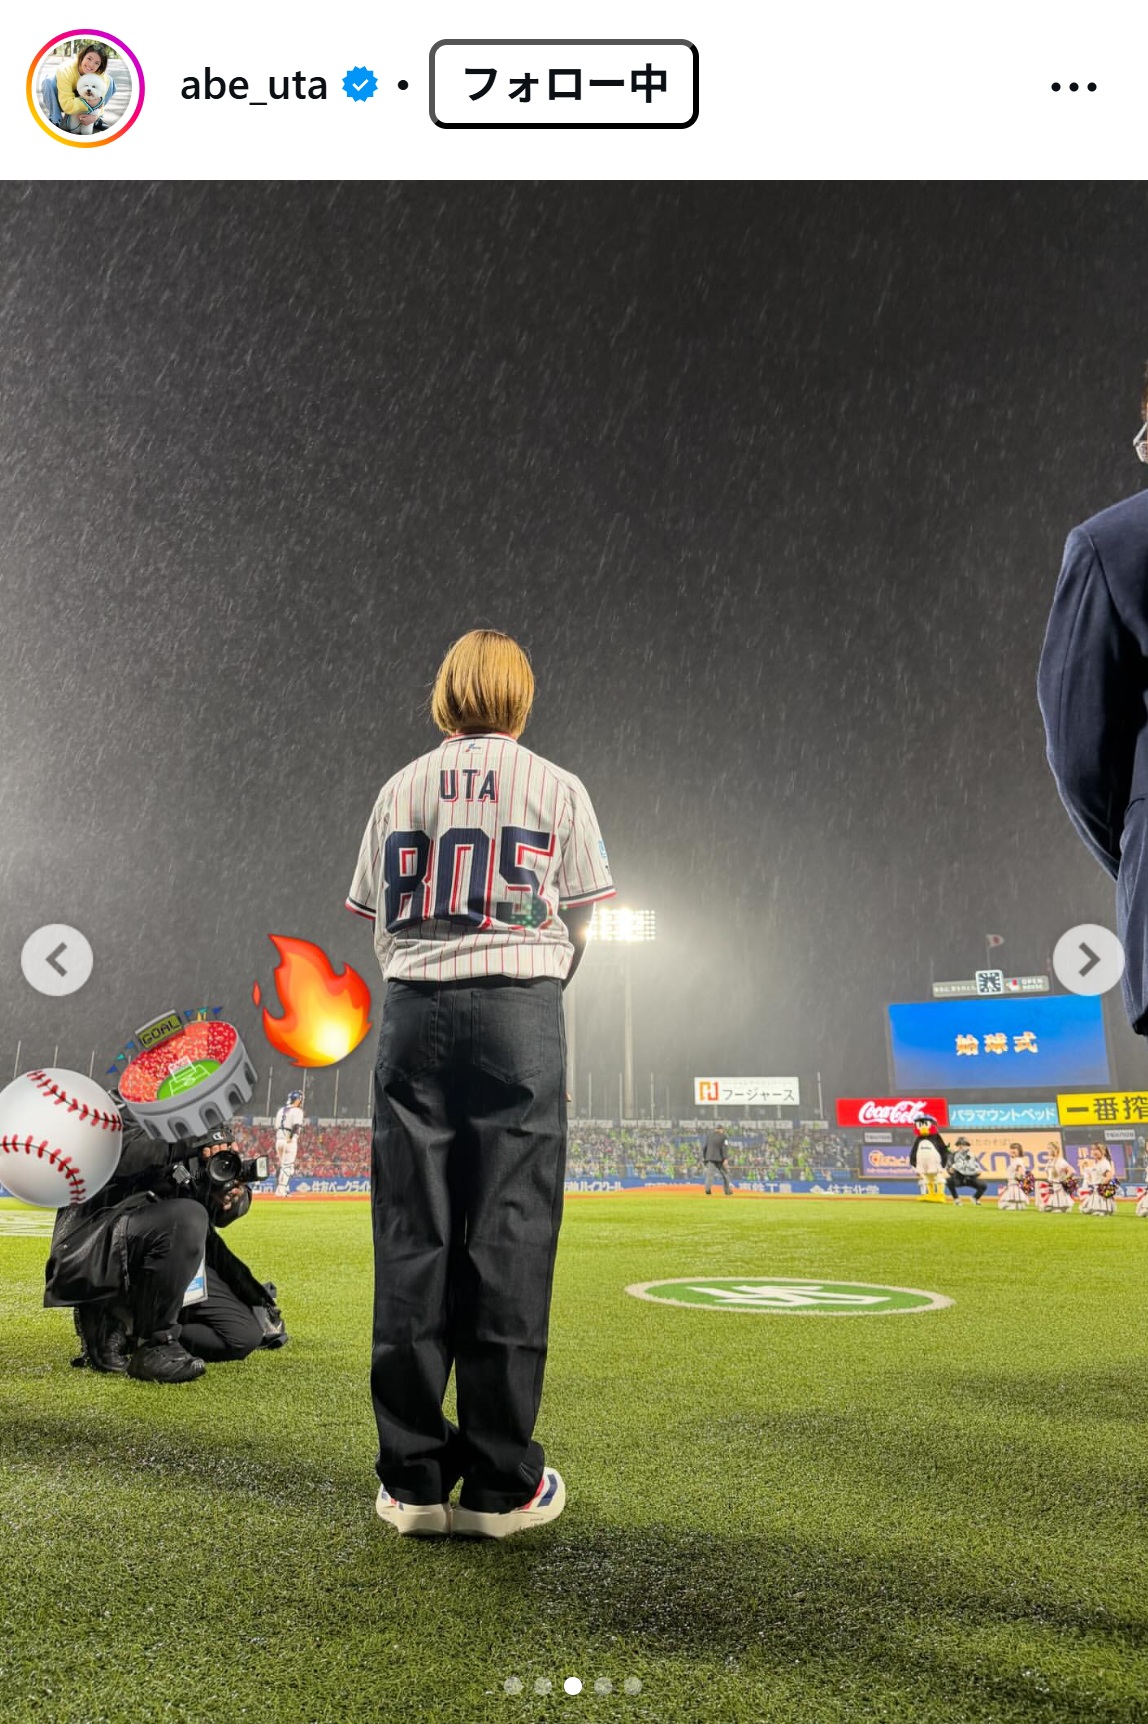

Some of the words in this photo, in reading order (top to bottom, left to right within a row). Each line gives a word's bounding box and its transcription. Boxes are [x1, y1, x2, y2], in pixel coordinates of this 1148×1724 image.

[440, 769, 498, 803] UTA
[384, 826, 556, 934] 805
[955, 1031, 1038, 1056] 始球式
[722, 1087, 795, 1102] フージャース
[951, 1107, 1056, 1122] パラマウントベッド
